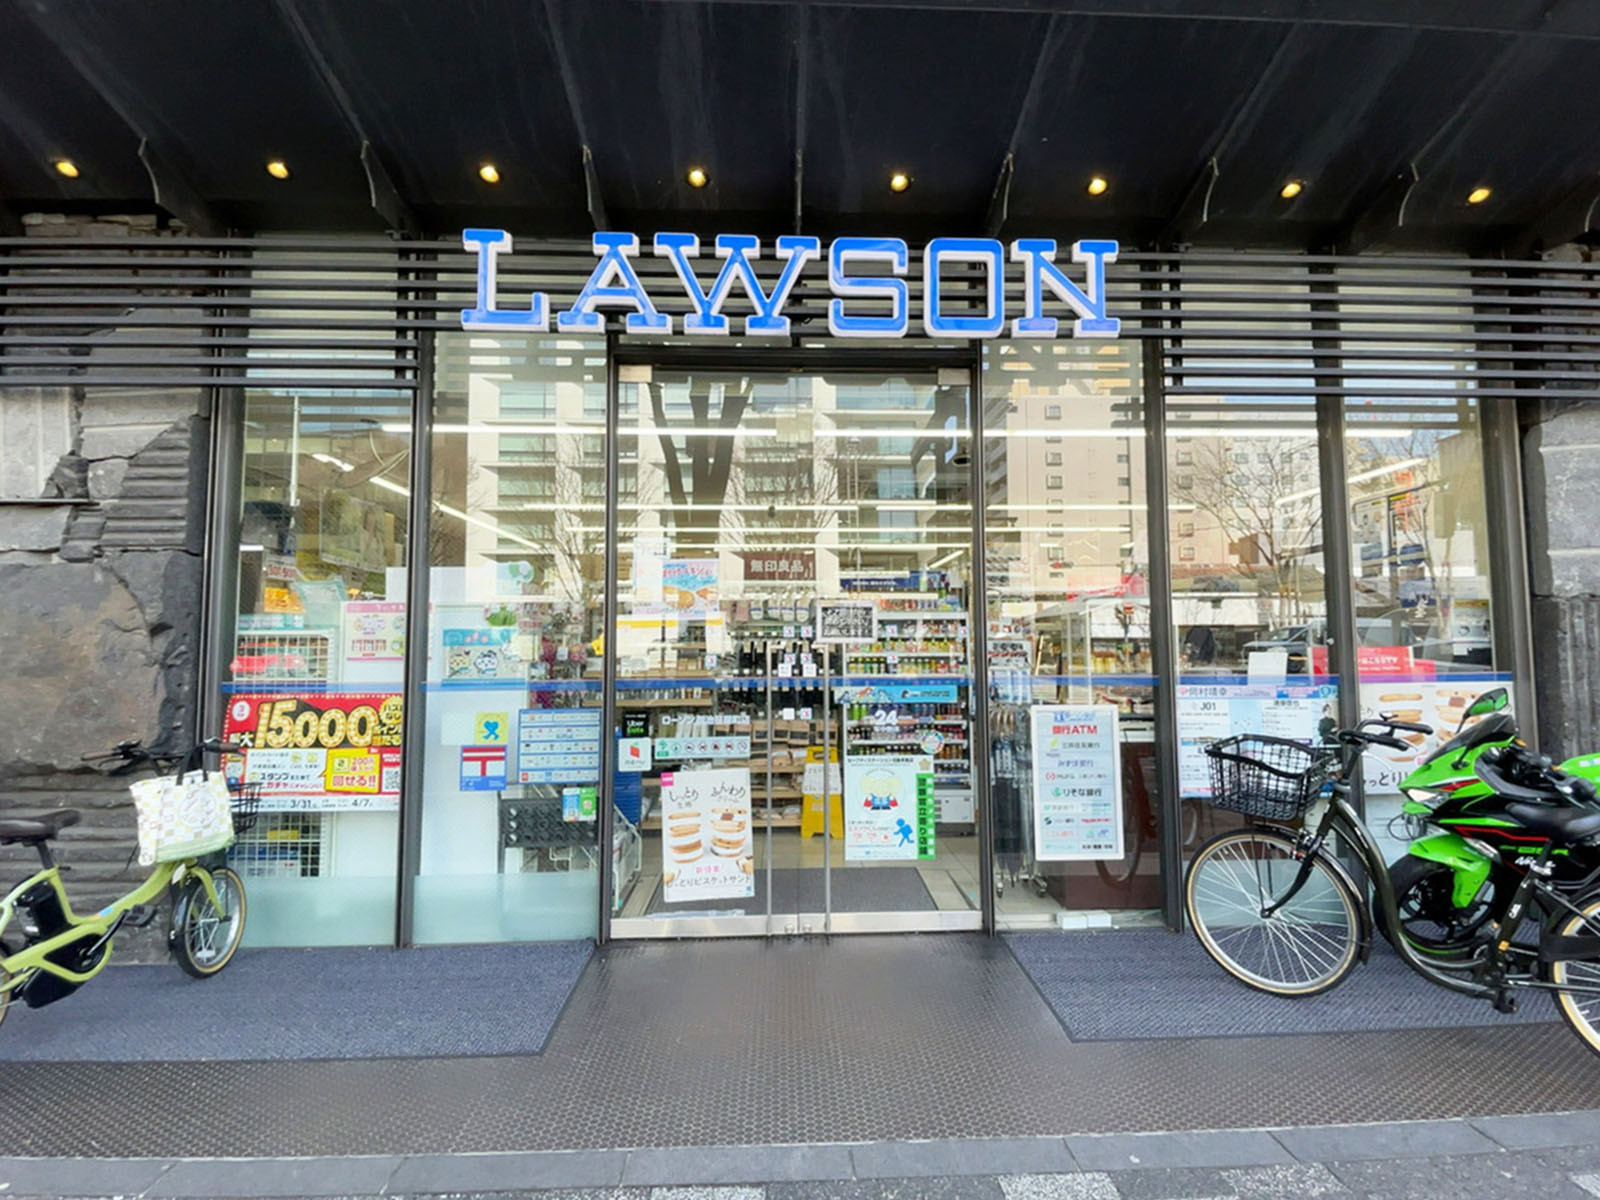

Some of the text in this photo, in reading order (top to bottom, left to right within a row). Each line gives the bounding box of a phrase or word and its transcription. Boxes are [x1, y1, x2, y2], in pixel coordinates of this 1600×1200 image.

[461, 228, 1122, 339] LAWSON
[751, 559, 804, 573] 無印良品
[255, 698, 380, 749] 15,000
[874, 709, 897, 726] 24
